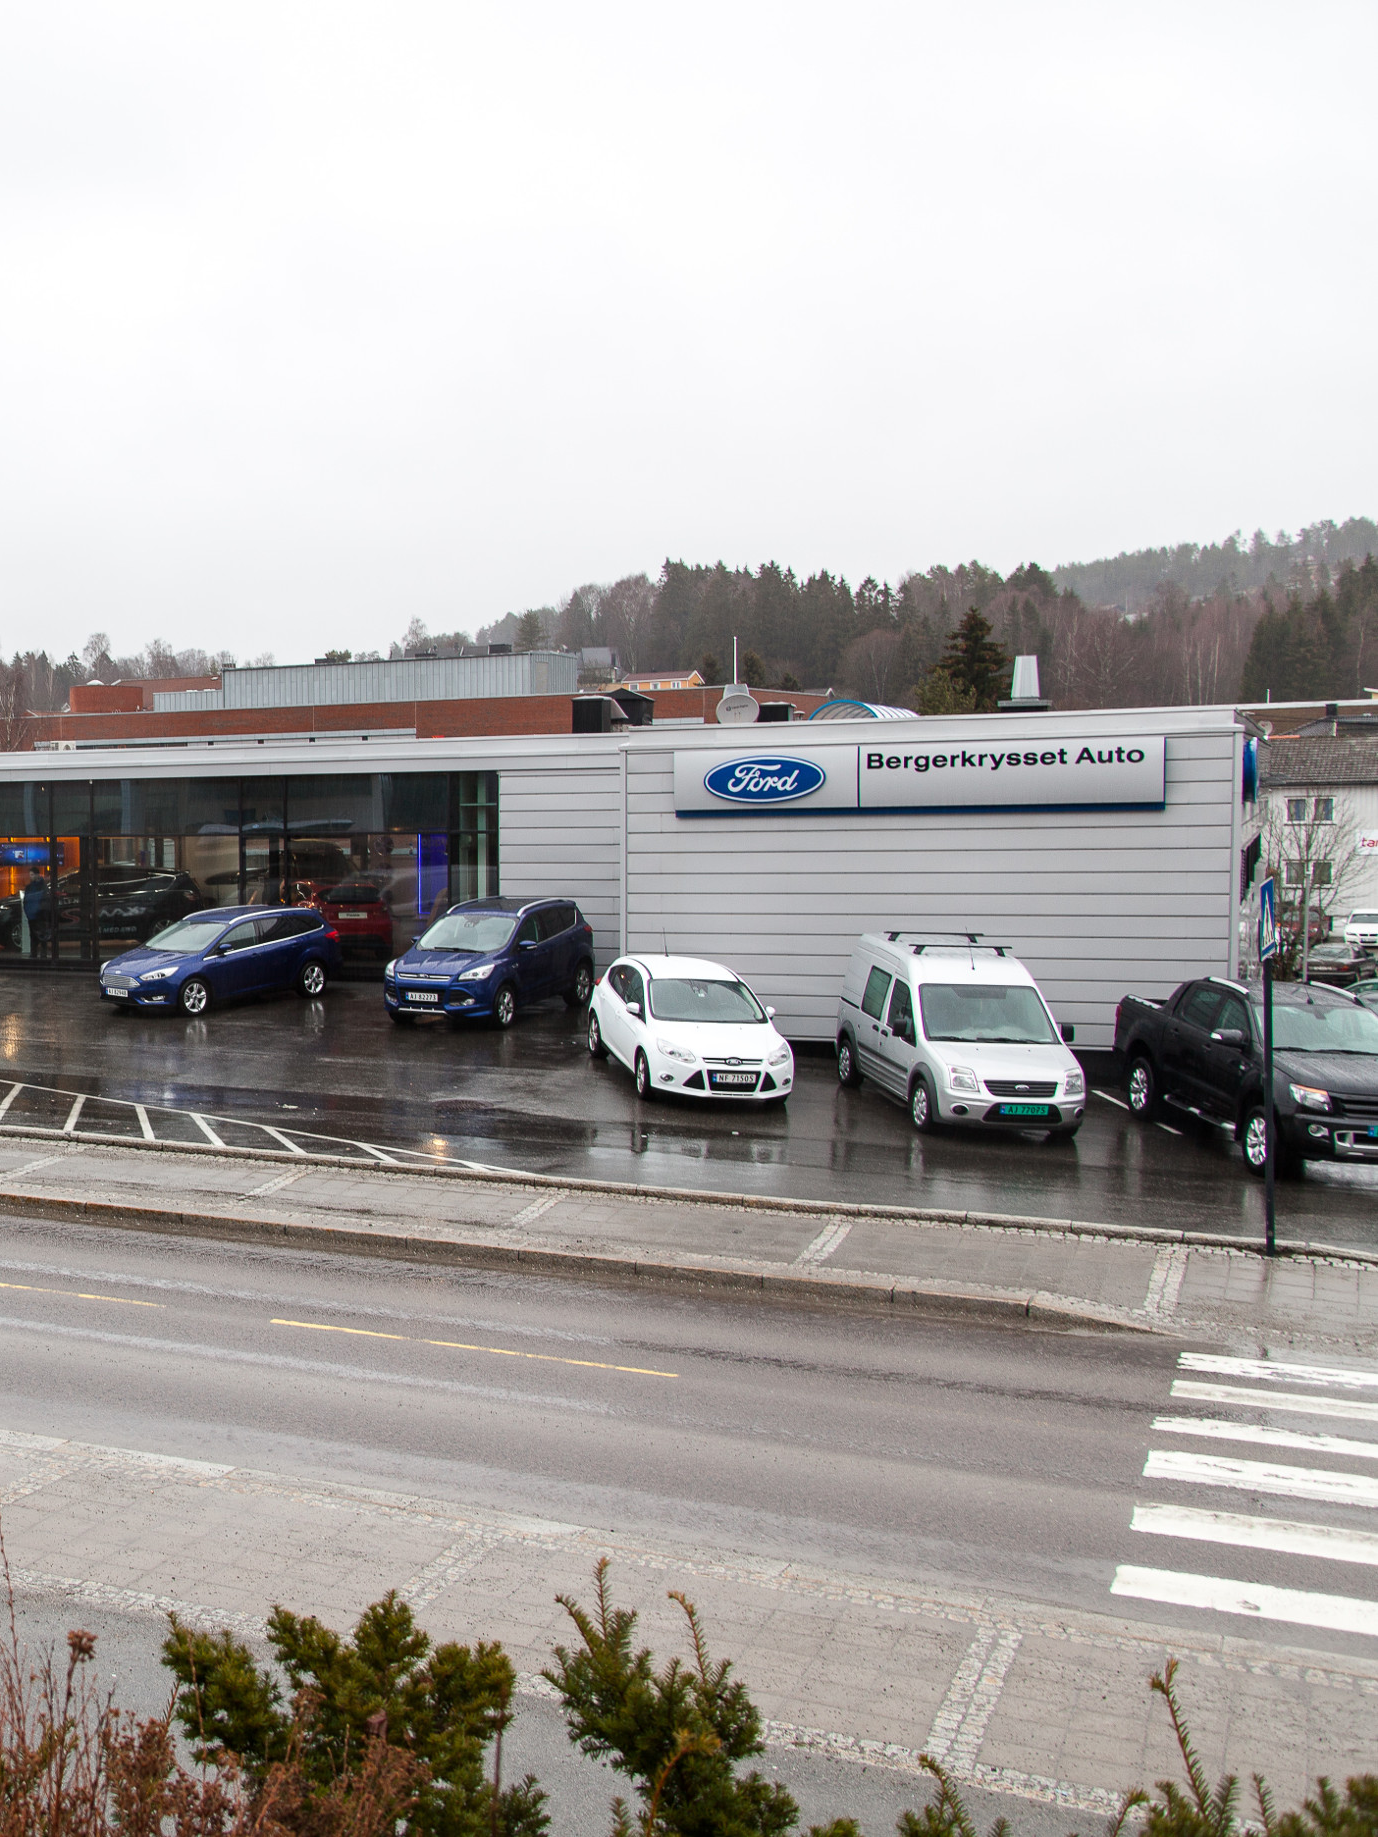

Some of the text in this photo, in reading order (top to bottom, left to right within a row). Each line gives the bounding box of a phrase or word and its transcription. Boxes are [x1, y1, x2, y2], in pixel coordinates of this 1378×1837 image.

[866, 747, 1145, 772] Bergerkrysset Auto
[727, 764, 799, 792] Ford
